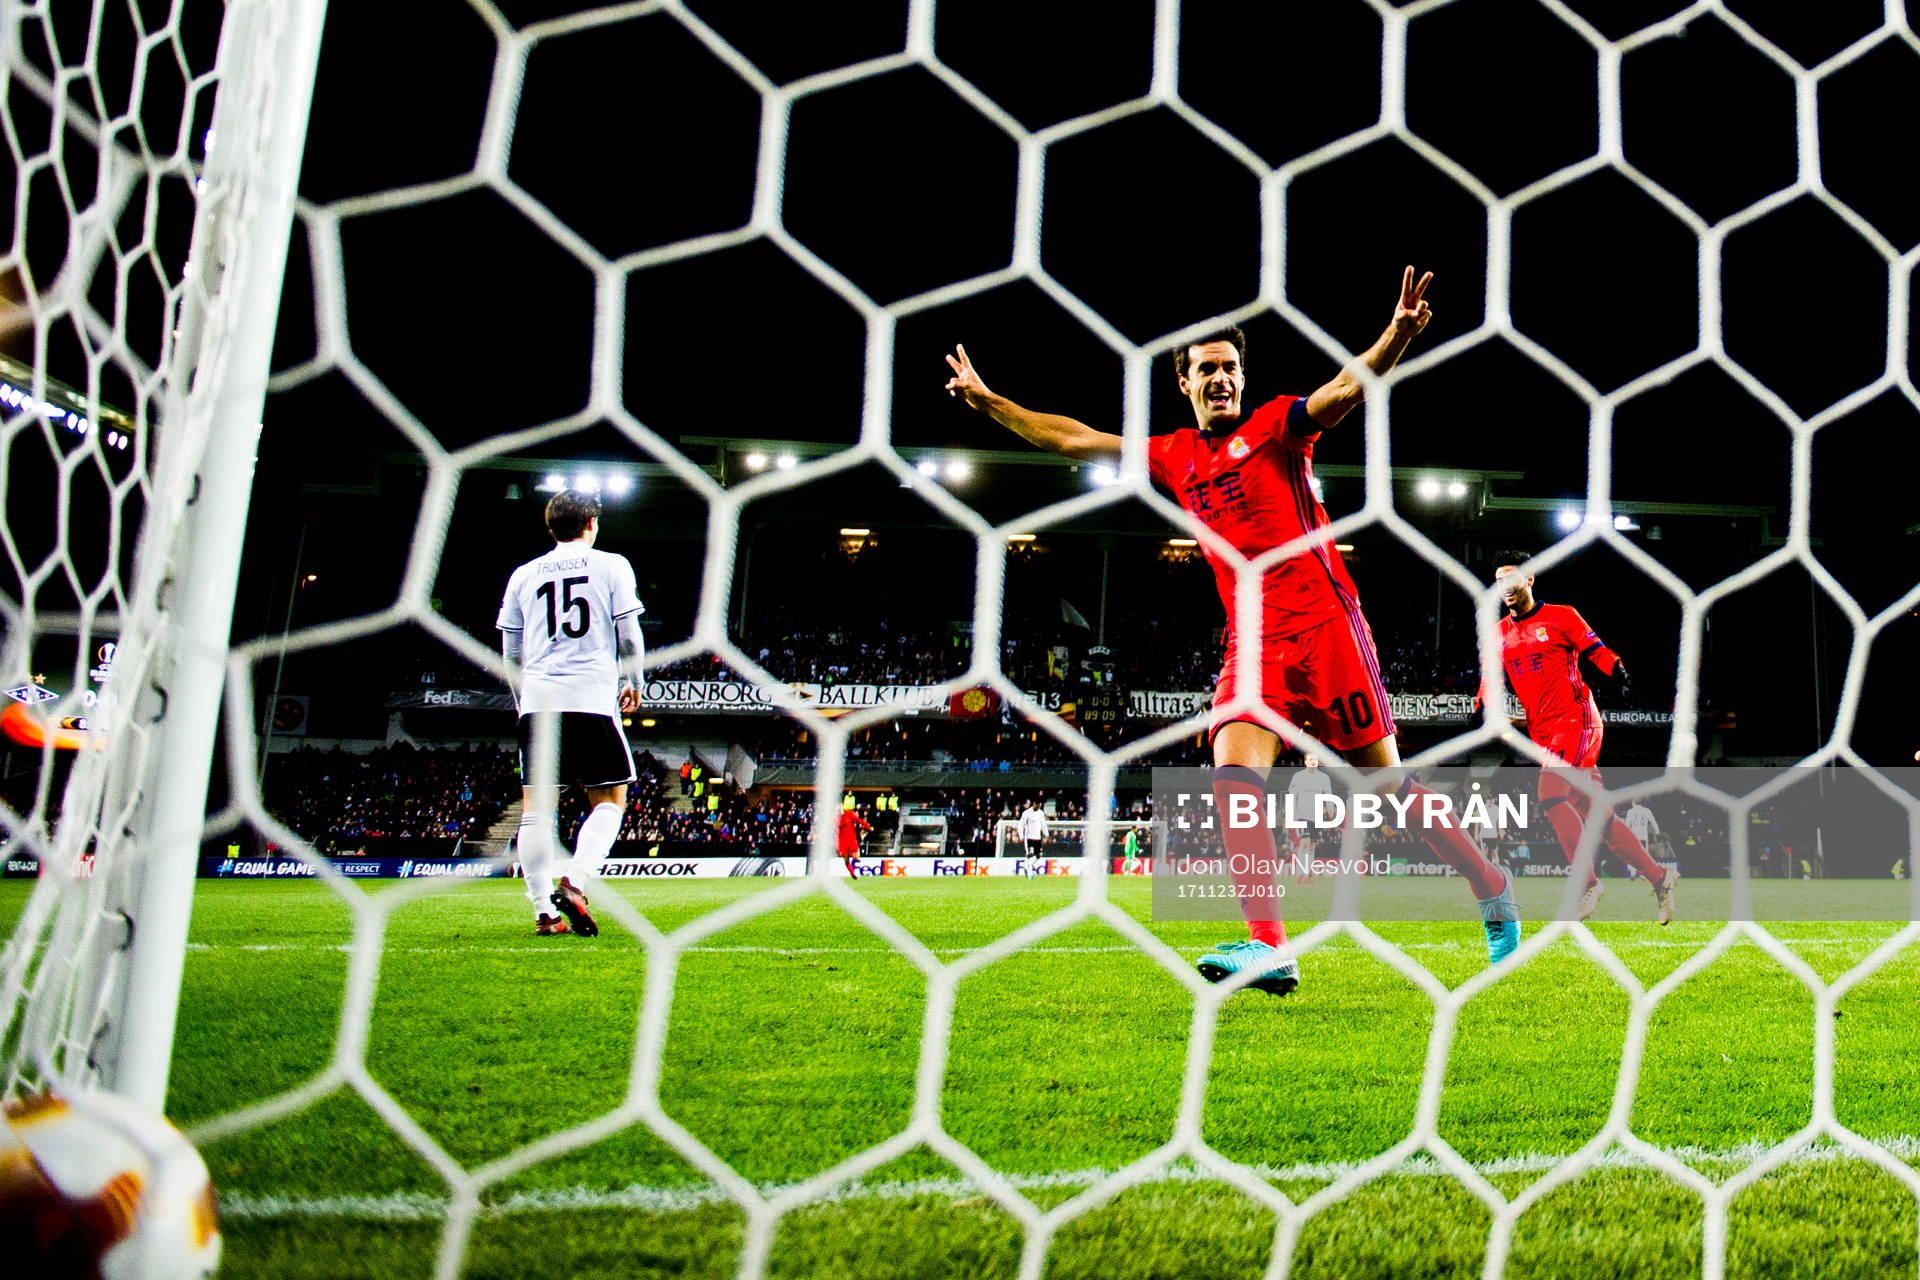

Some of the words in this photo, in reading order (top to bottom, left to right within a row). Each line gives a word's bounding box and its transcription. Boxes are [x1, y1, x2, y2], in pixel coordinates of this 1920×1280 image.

[537, 557, 589, 575] TRONDSEN
[536, 576, 590, 642] 15
[424, 690, 470, 704] FedEx
[1330, 690, 1373, 735] 10
[1610, 712, 1652, 723] EUROPA
[277, 862, 316, 876] GAME
[344, 865, 380, 873] RESPECT
[455, 863, 493, 876] GAME
[852, 859, 907, 876] FedEx
[933, 859, 990, 876] FedEx
